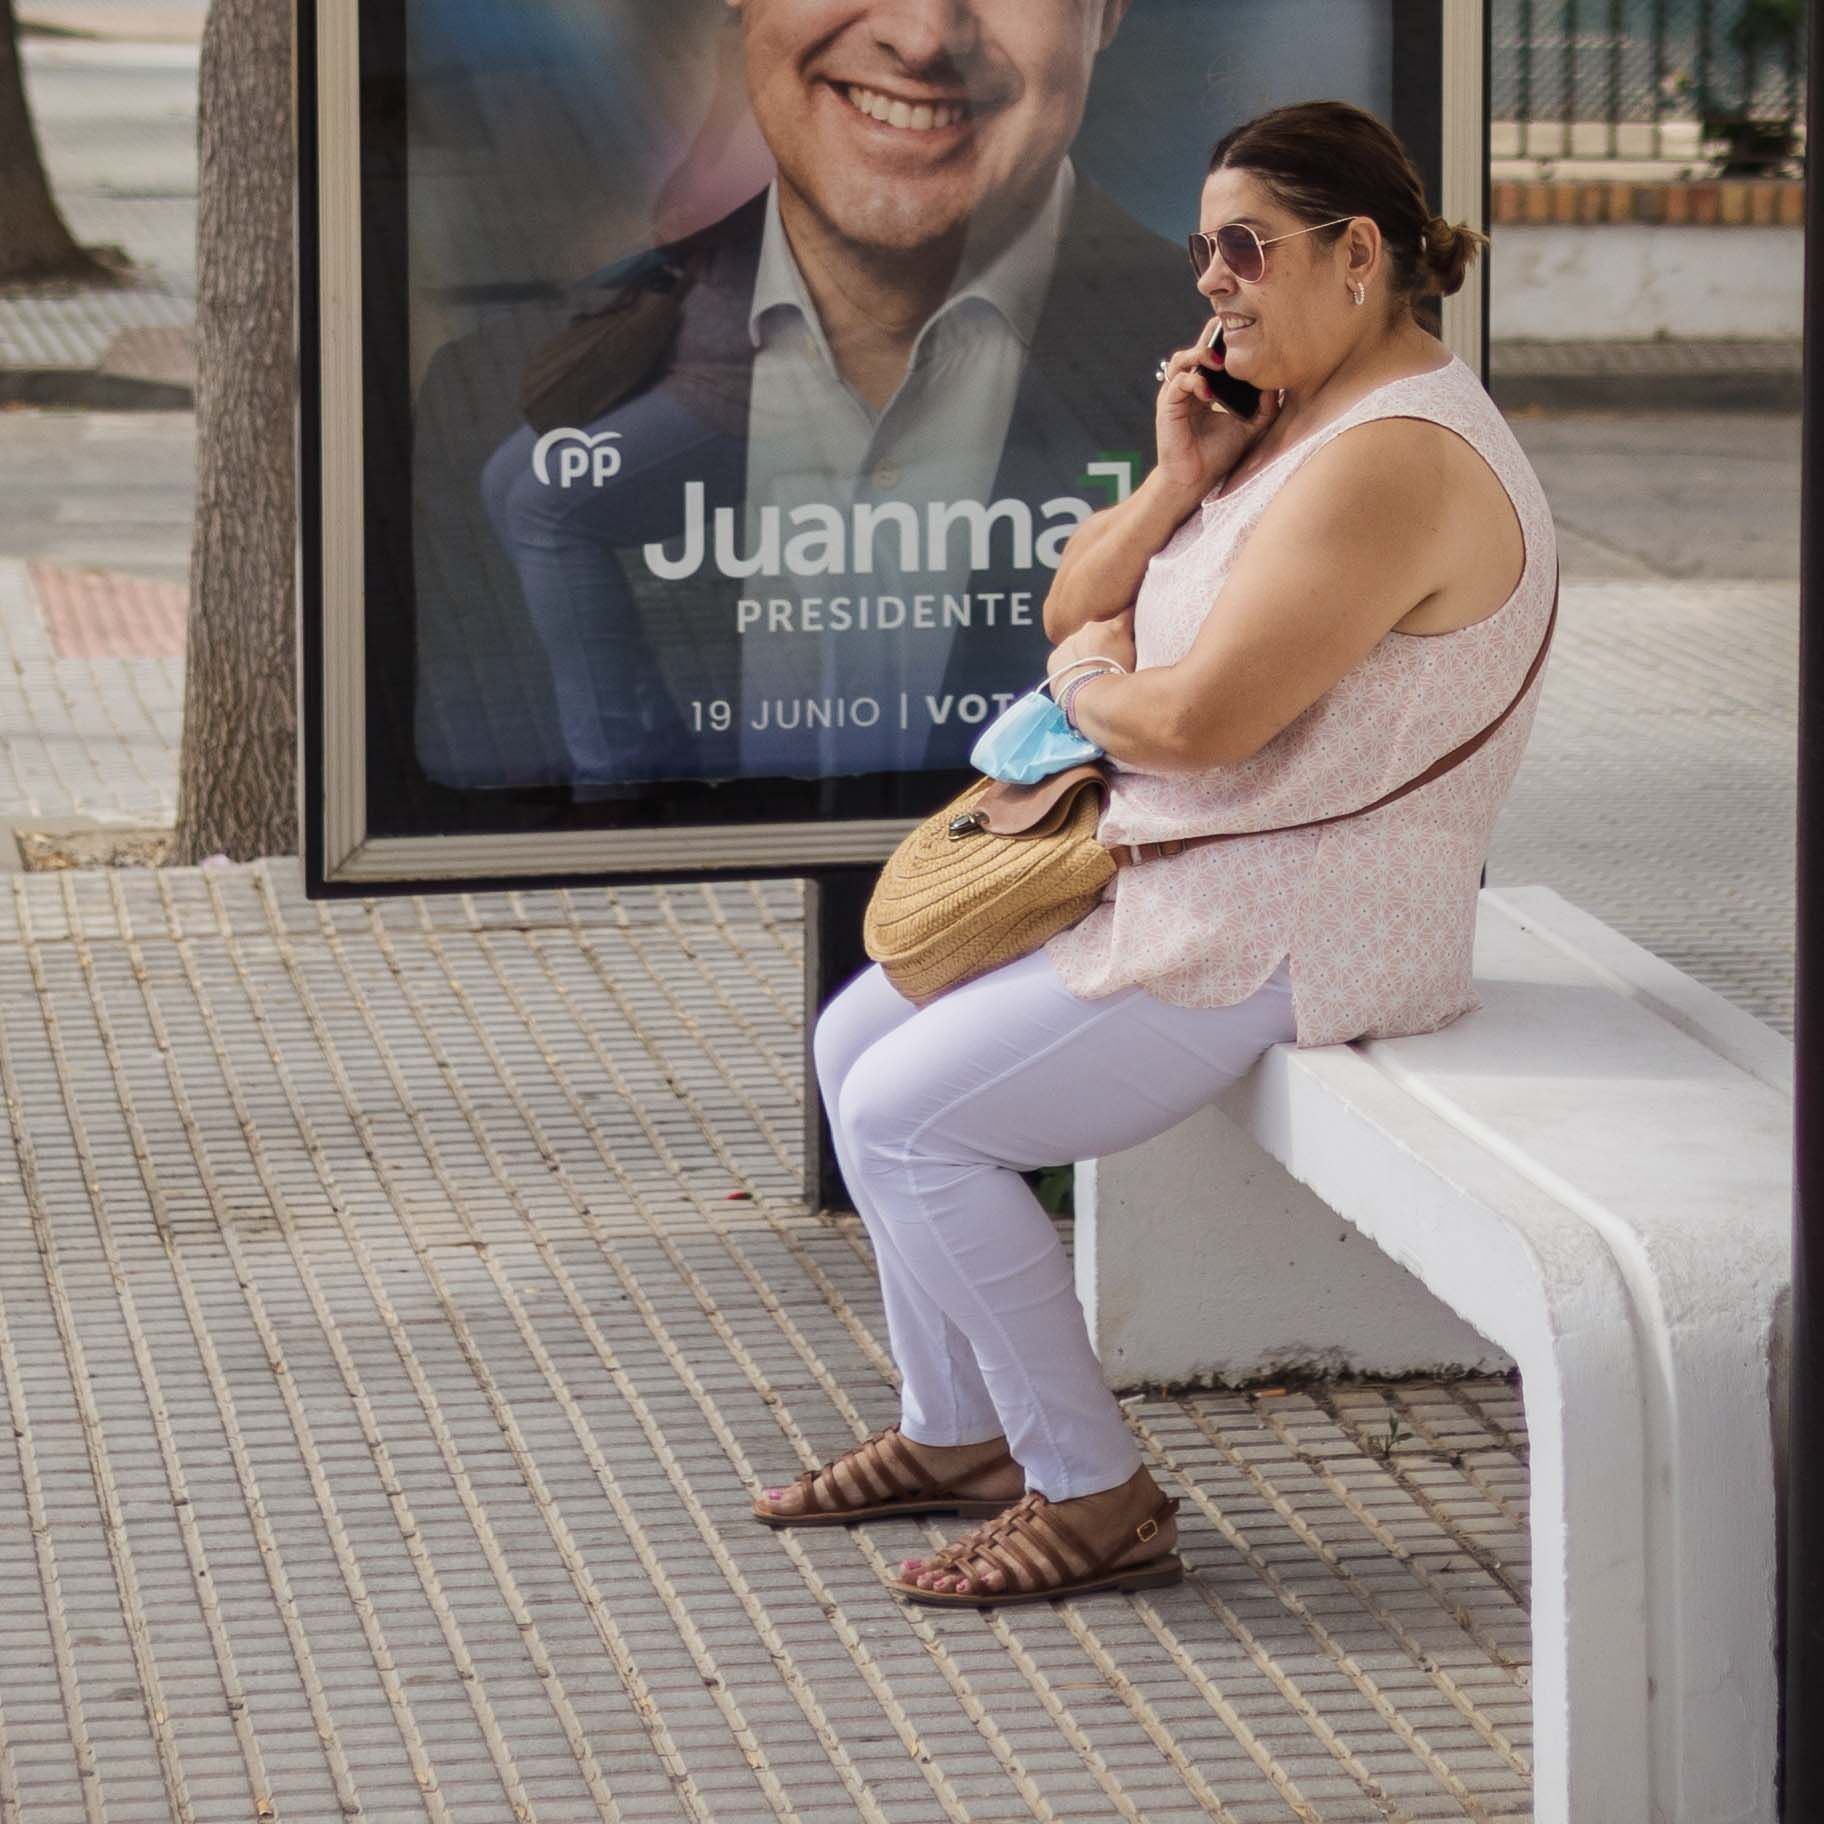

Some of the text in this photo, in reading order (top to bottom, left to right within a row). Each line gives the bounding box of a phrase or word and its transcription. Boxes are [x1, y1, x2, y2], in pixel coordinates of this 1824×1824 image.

[643, 480, 1095, 581] Juanma
[736, 592, 1034, 633] PRESIDENTE
[691, 699, 732, 732] 19
[751, 696, 881, 731] JUNIO
[926, 692, 1014, 725] VOT
